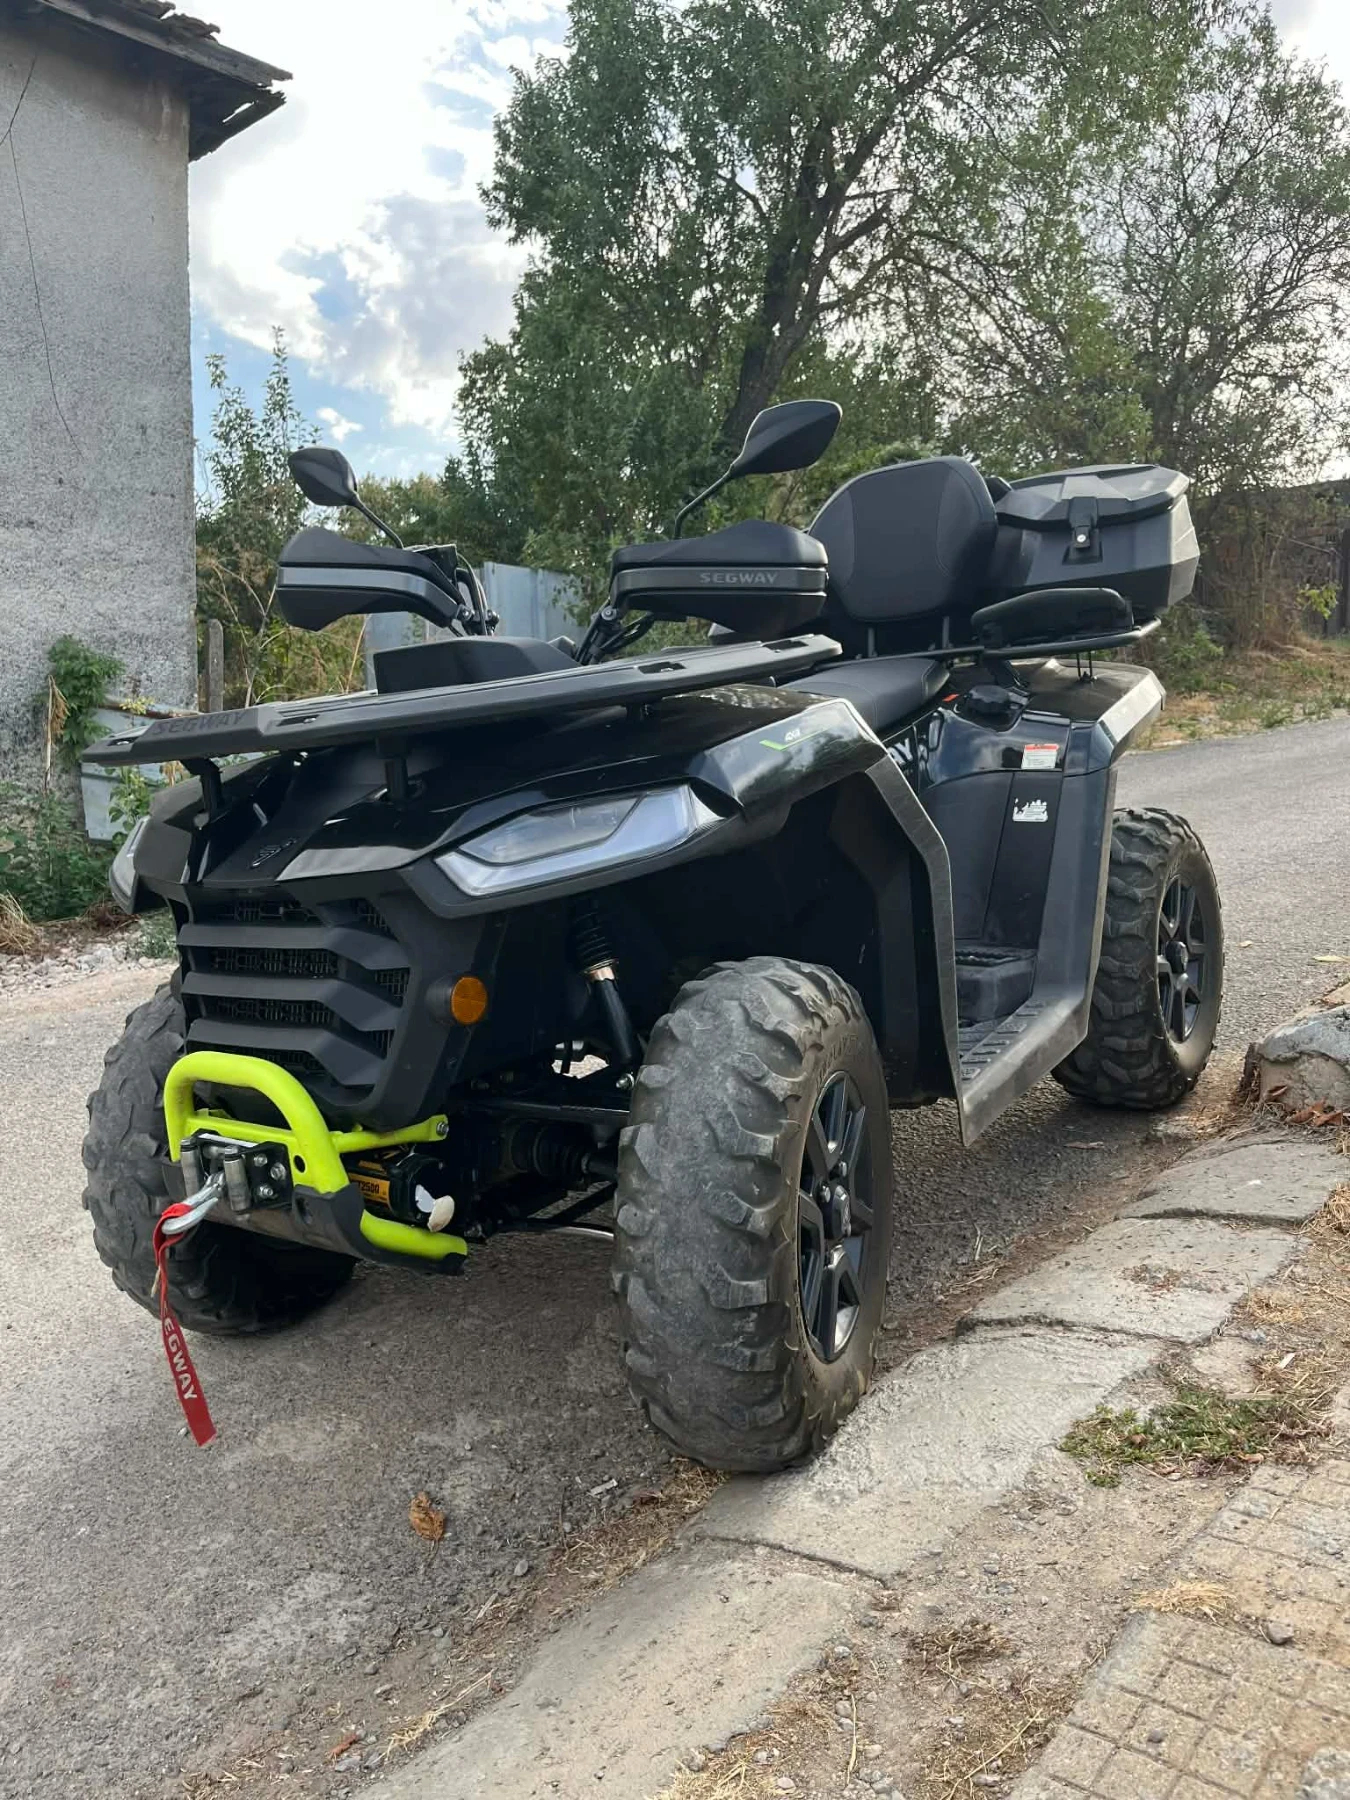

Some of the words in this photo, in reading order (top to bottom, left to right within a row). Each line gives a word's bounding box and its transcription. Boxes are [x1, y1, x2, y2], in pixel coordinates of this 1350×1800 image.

[699, 571, 778, 585] SEGWAY
[154, 711, 247, 735] SEGWAY
[163, 1304, 198, 1400] EGWAY
